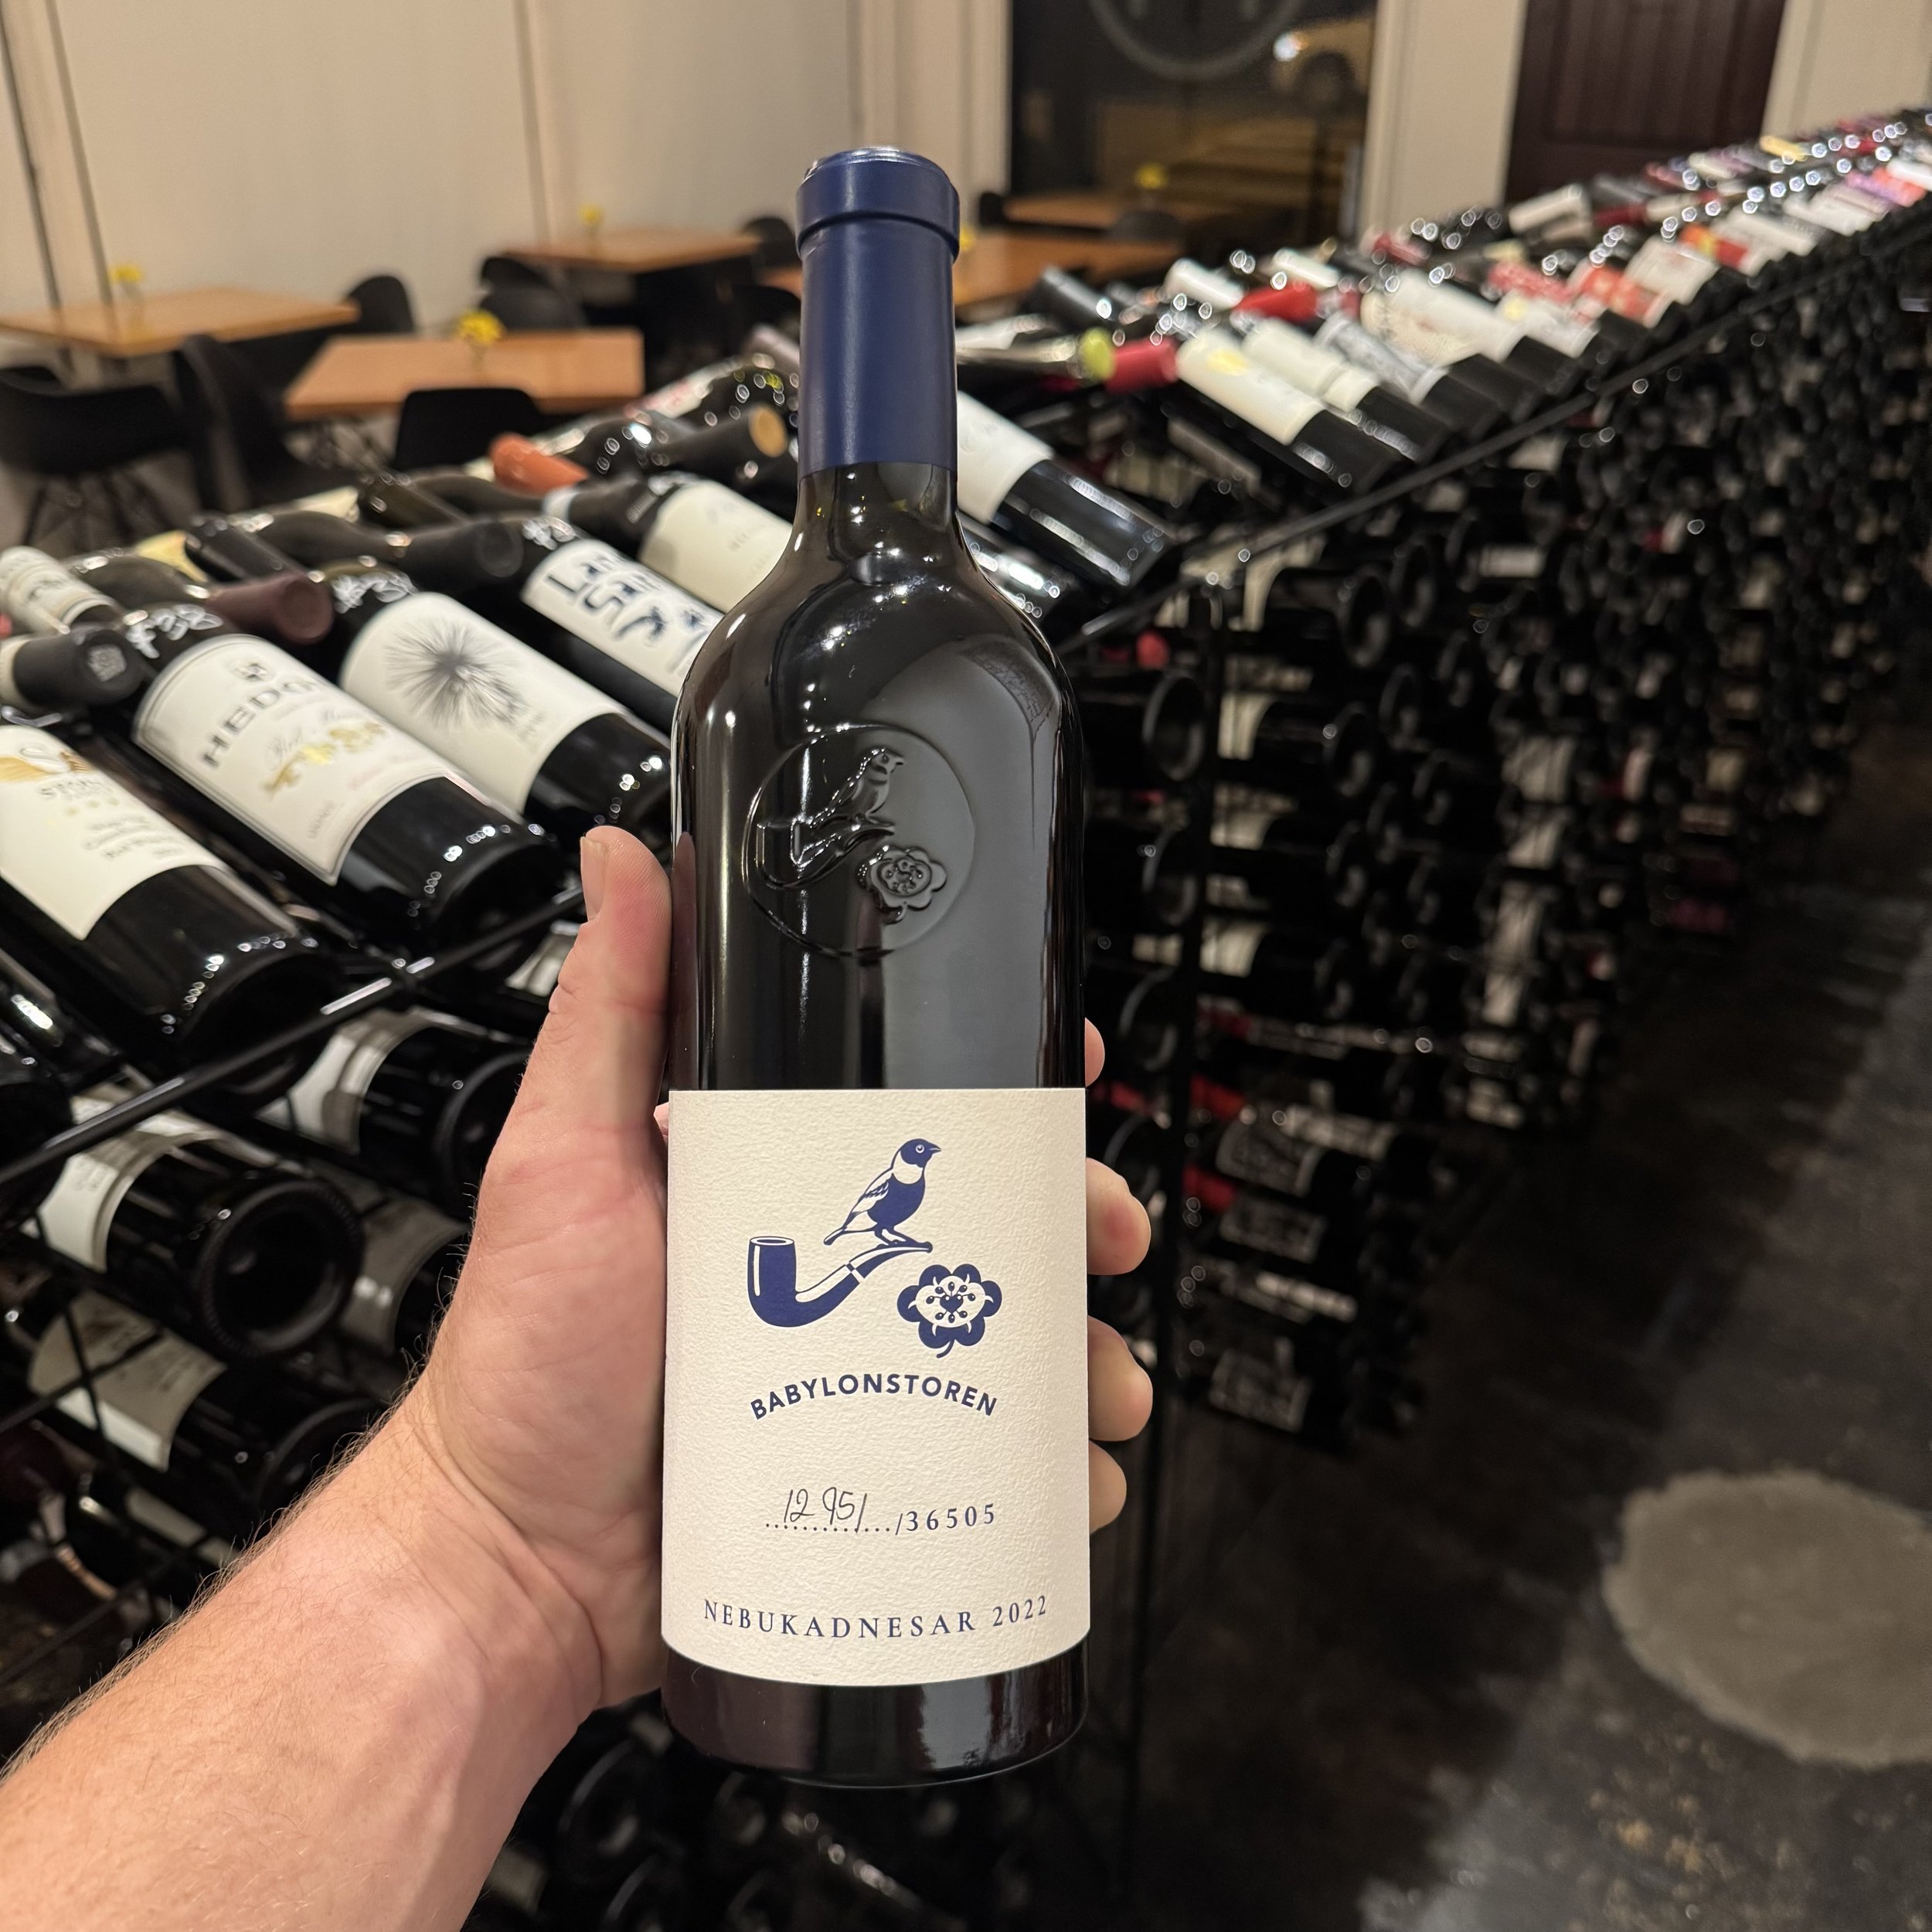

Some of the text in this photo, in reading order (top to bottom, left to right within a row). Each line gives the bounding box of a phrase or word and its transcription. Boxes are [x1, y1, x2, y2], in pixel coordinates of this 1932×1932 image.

[750, 1372, 998, 1420] BABYLONSTOREN
[704, 1594, 1046, 1639] NEBUKADNESAR 2022
